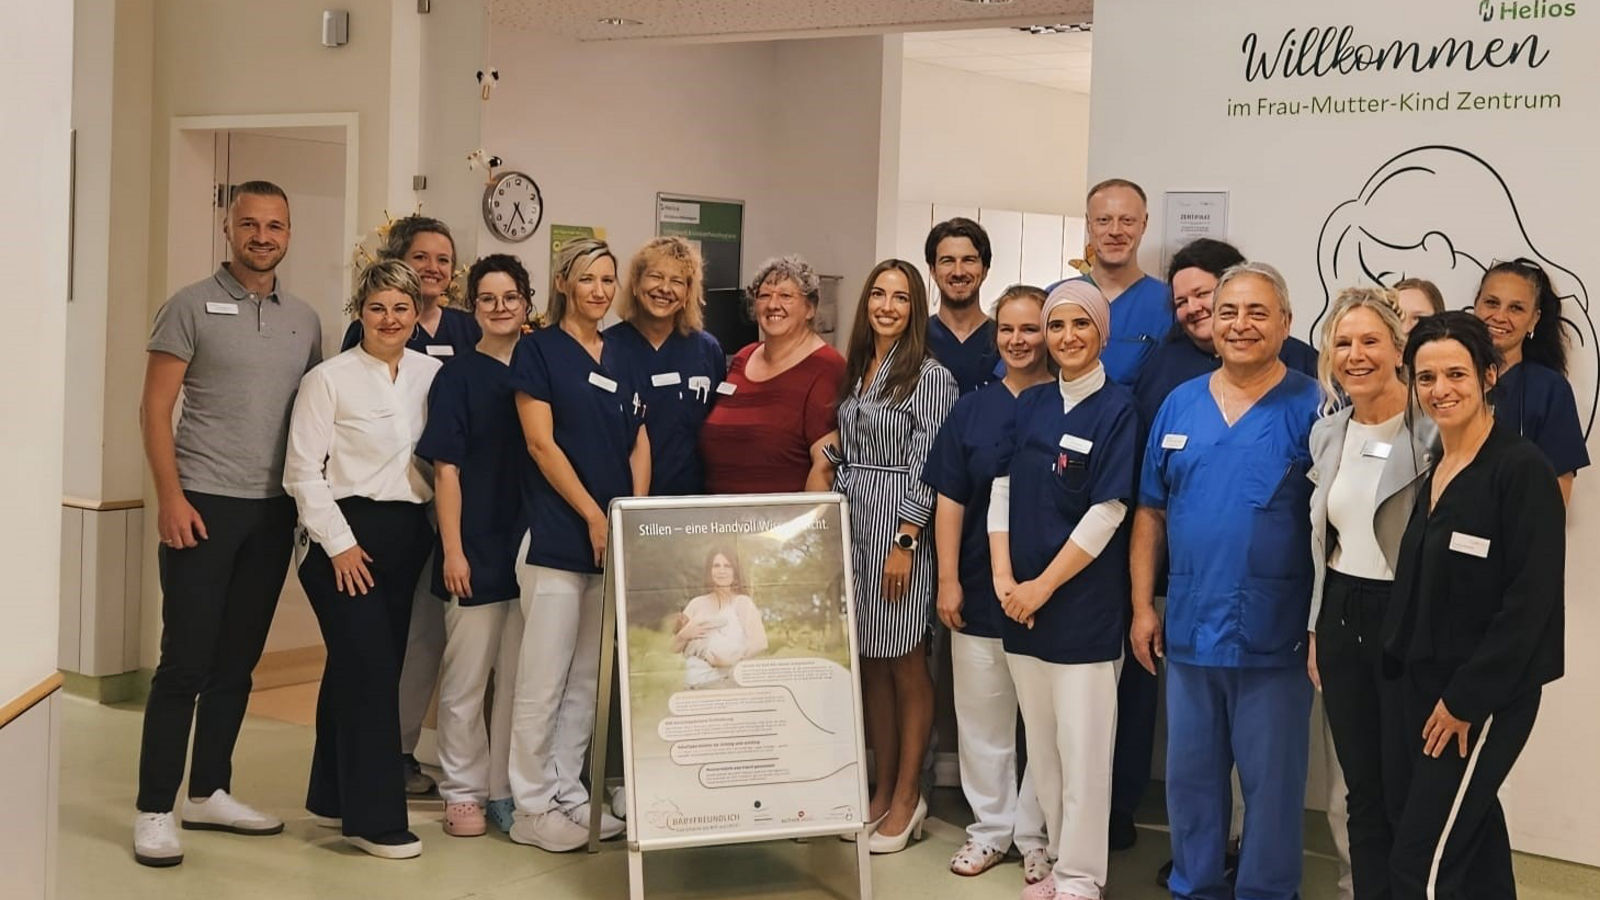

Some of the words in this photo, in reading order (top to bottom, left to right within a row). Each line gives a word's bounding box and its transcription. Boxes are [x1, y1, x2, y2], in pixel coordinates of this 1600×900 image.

[1499, 0, 1576, 20] Helios
[1242, 25, 1550, 82] Willkommen
[1227, 98, 1251, 116] im
[1257, 90, 1449, 116] Frau-Mutter-Kind
[1456, 91, 1561, 111] Zentrum
[639, 523, 672, 536] Stillen
[685, 521, 708, 534] eine
[710, 518, 756, 534] Handvoll
